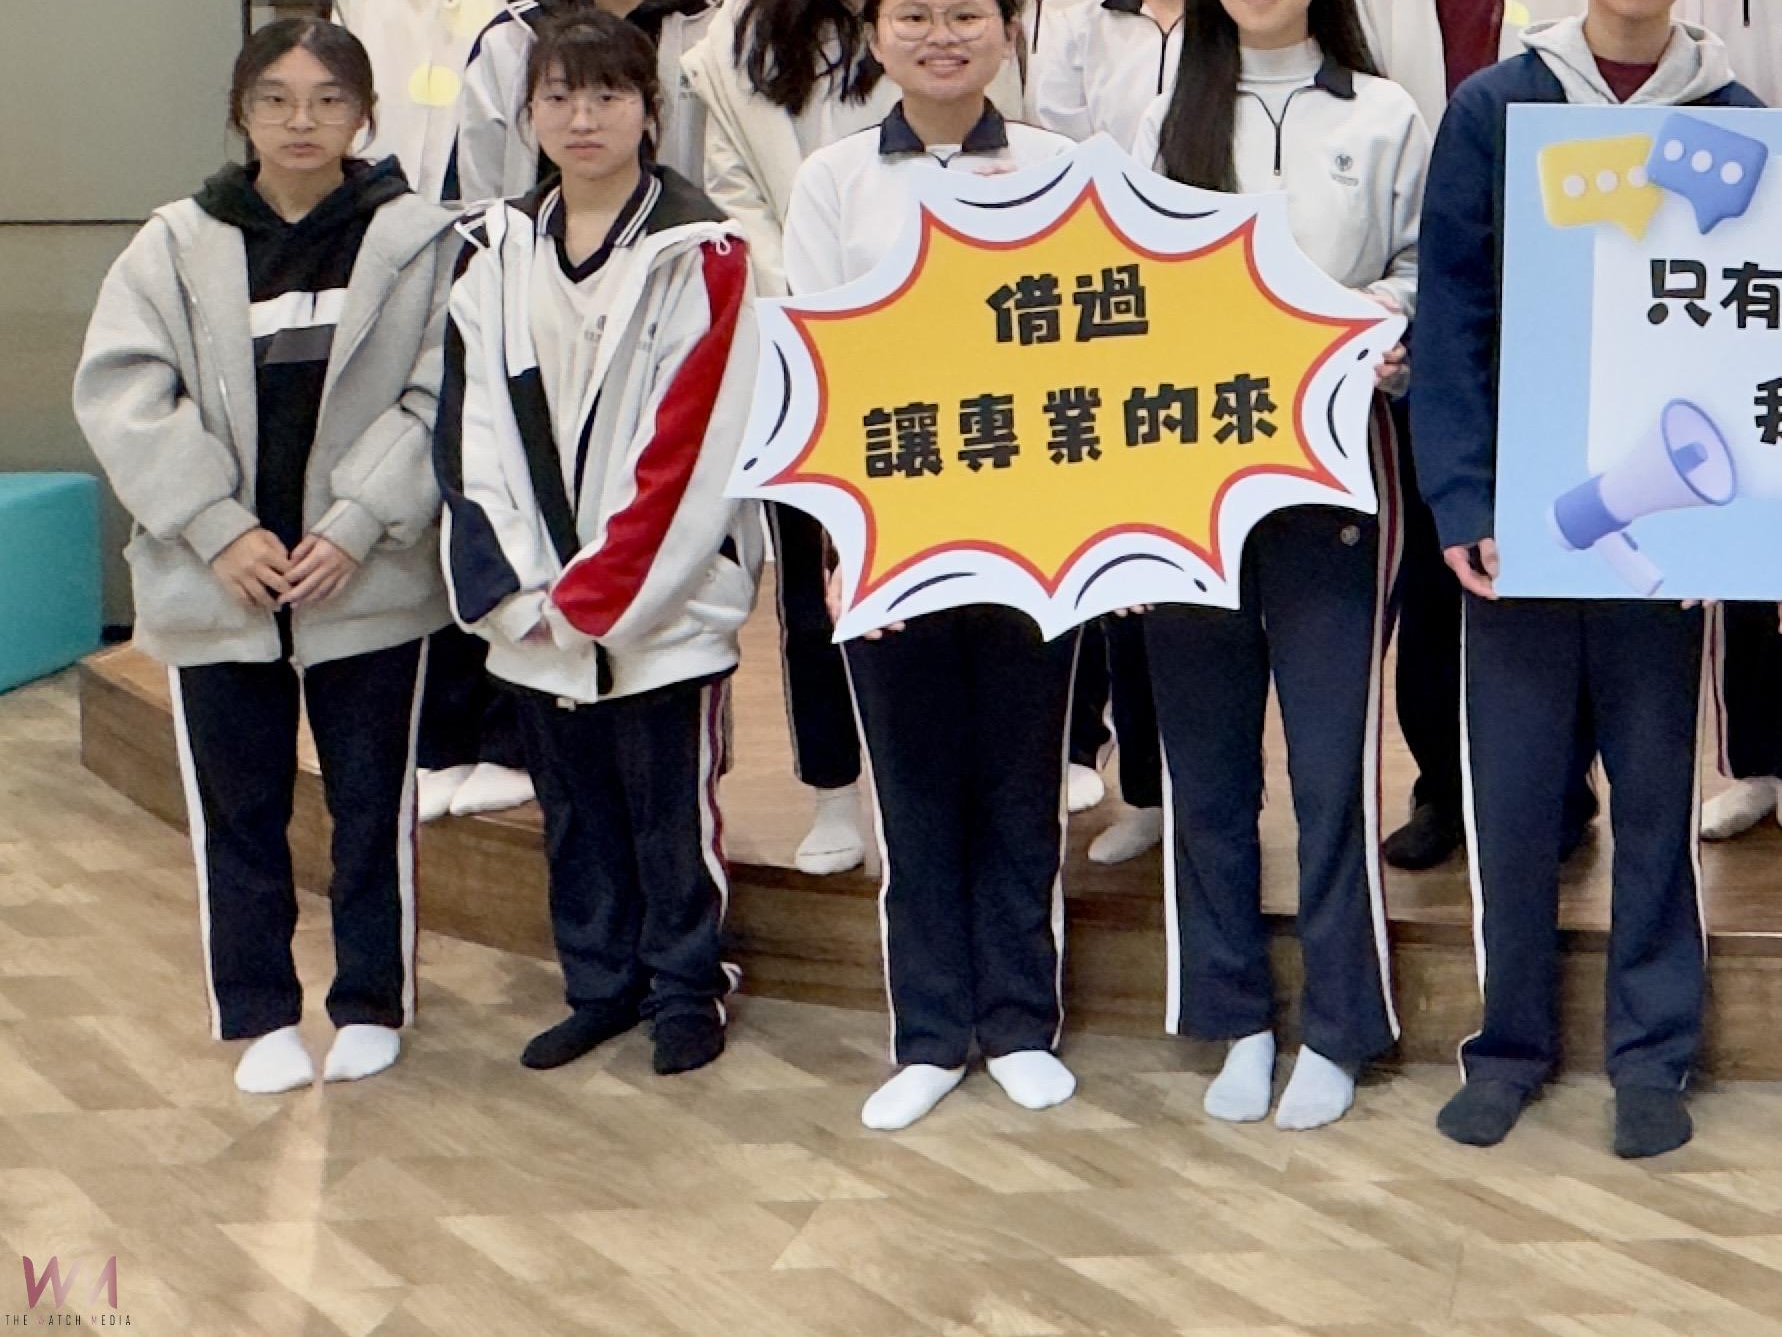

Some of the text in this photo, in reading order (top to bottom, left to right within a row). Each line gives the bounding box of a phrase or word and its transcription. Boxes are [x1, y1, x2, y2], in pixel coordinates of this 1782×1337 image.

[985, 263, 1150, 346] 借過
[862, 372, 1279, 479] 讓專業的來
